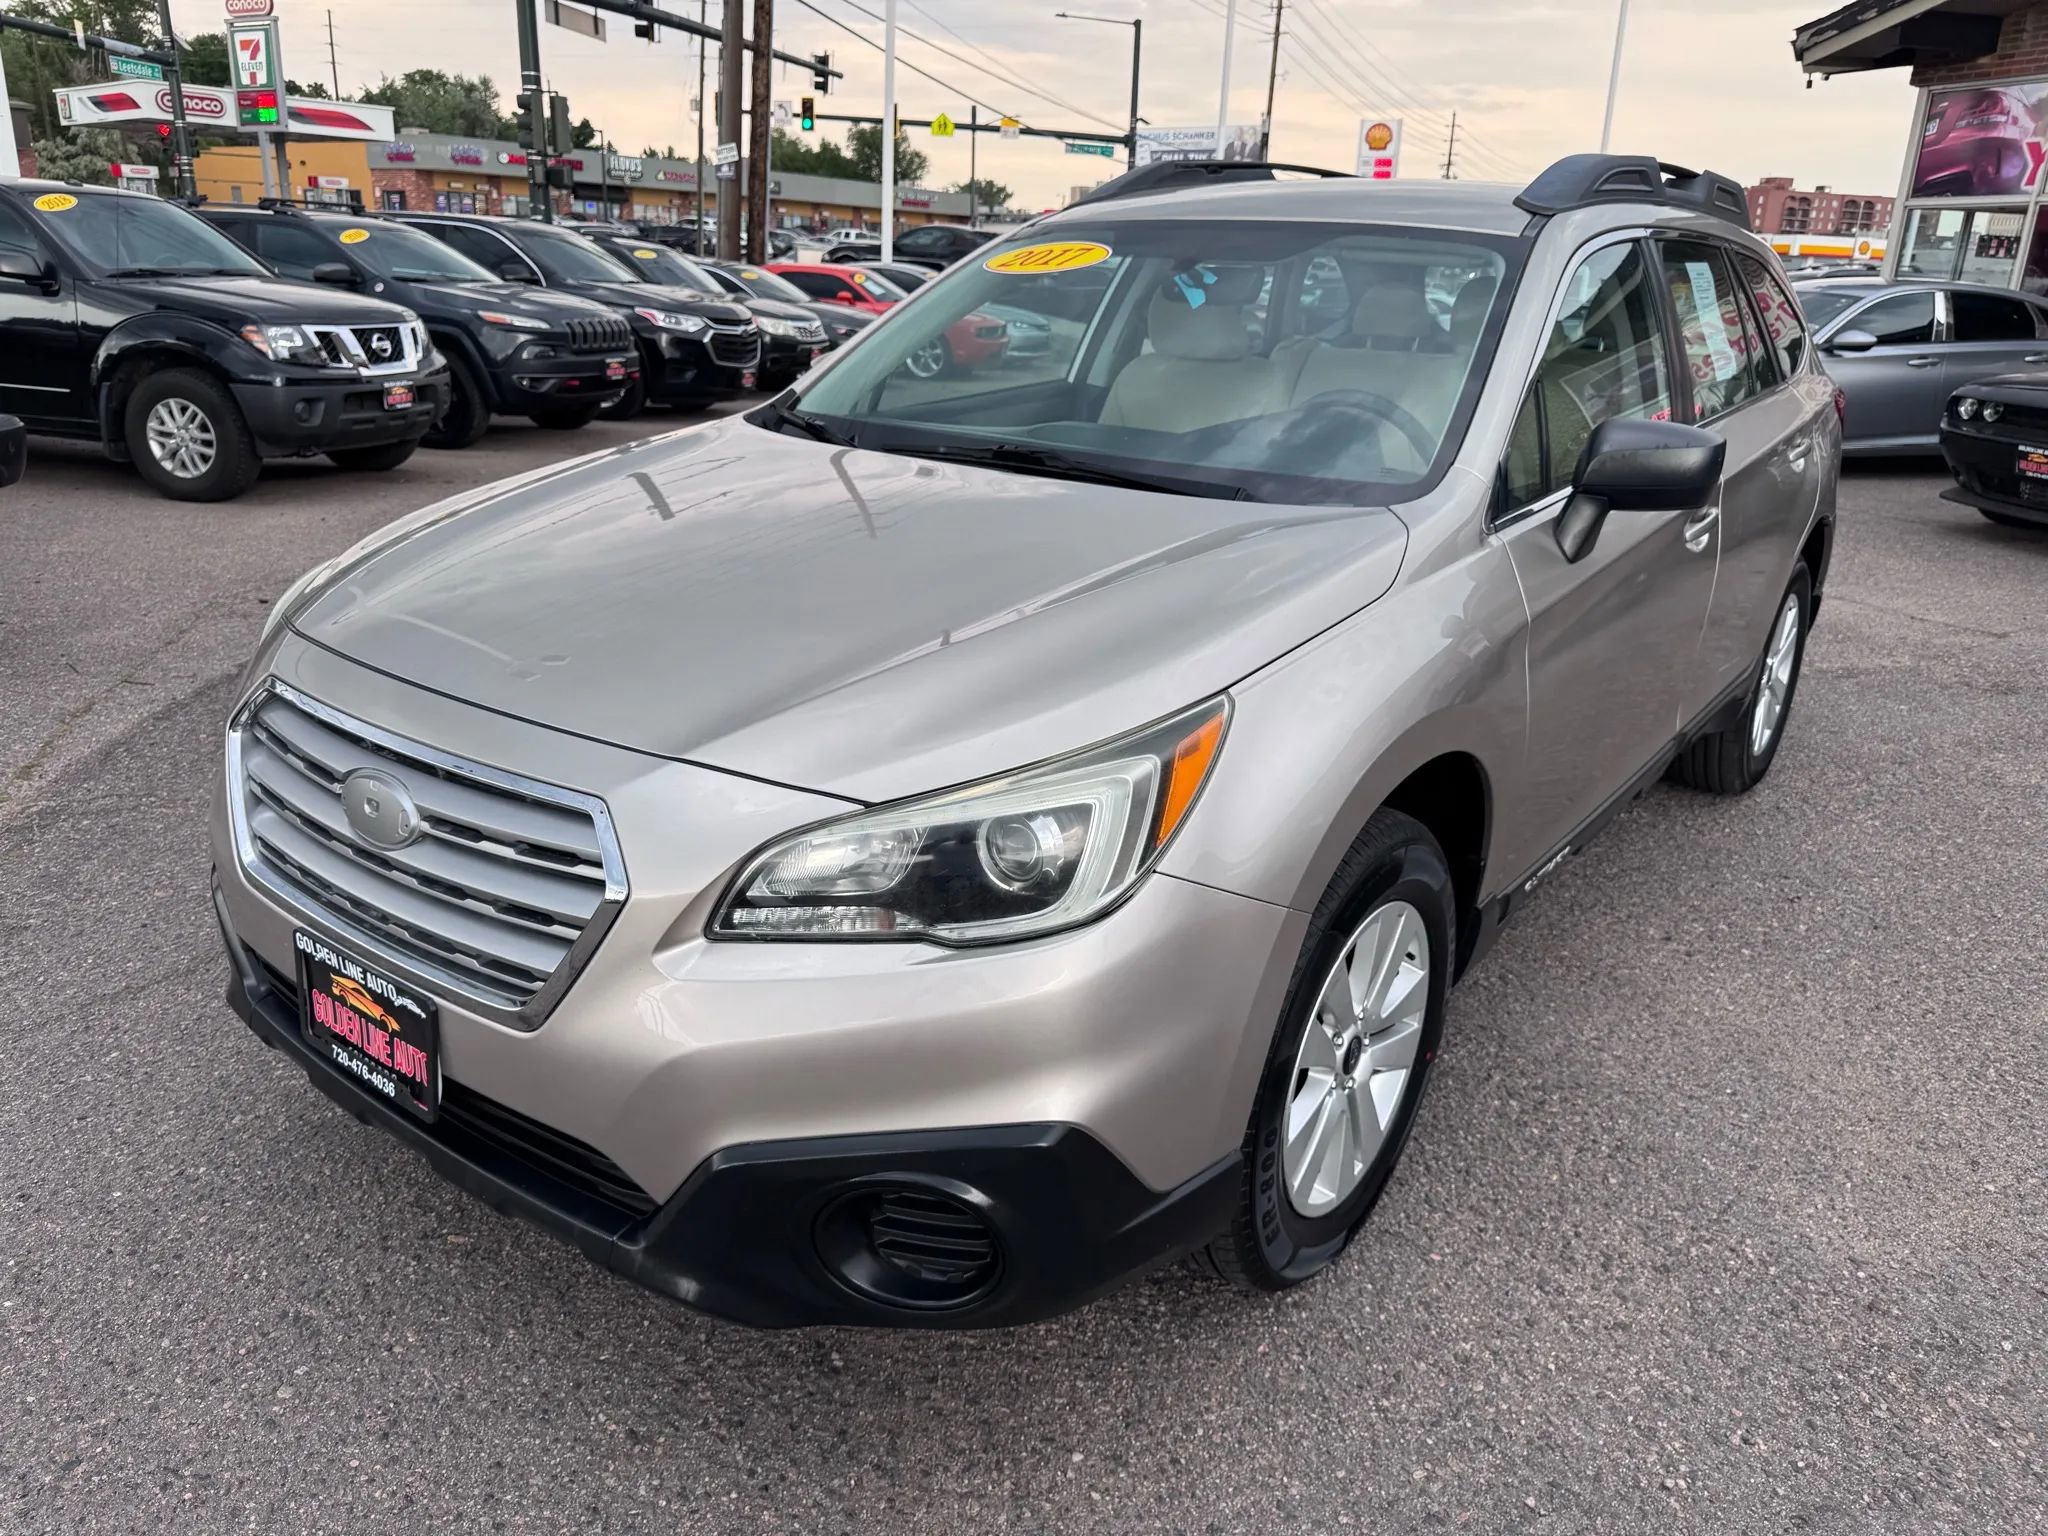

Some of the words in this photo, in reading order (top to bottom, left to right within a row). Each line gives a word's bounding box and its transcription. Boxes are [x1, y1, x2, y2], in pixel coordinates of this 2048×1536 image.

[119, 60, 153, 77] Leetsdale
[162, 95, 222, 112] cnoco
[997, 247, 1096, 268] 2017
[295, 932, 342, 971] GOLDEN
[339, 956, 366, 985] LINE
[366, 972, 397, 1001] AUTO
[312, 988, 363, 1049] GOLDEN
[361, 1017, 393, 1067] LINE
[331, 1043, 397, 1098] 720-476-4036
